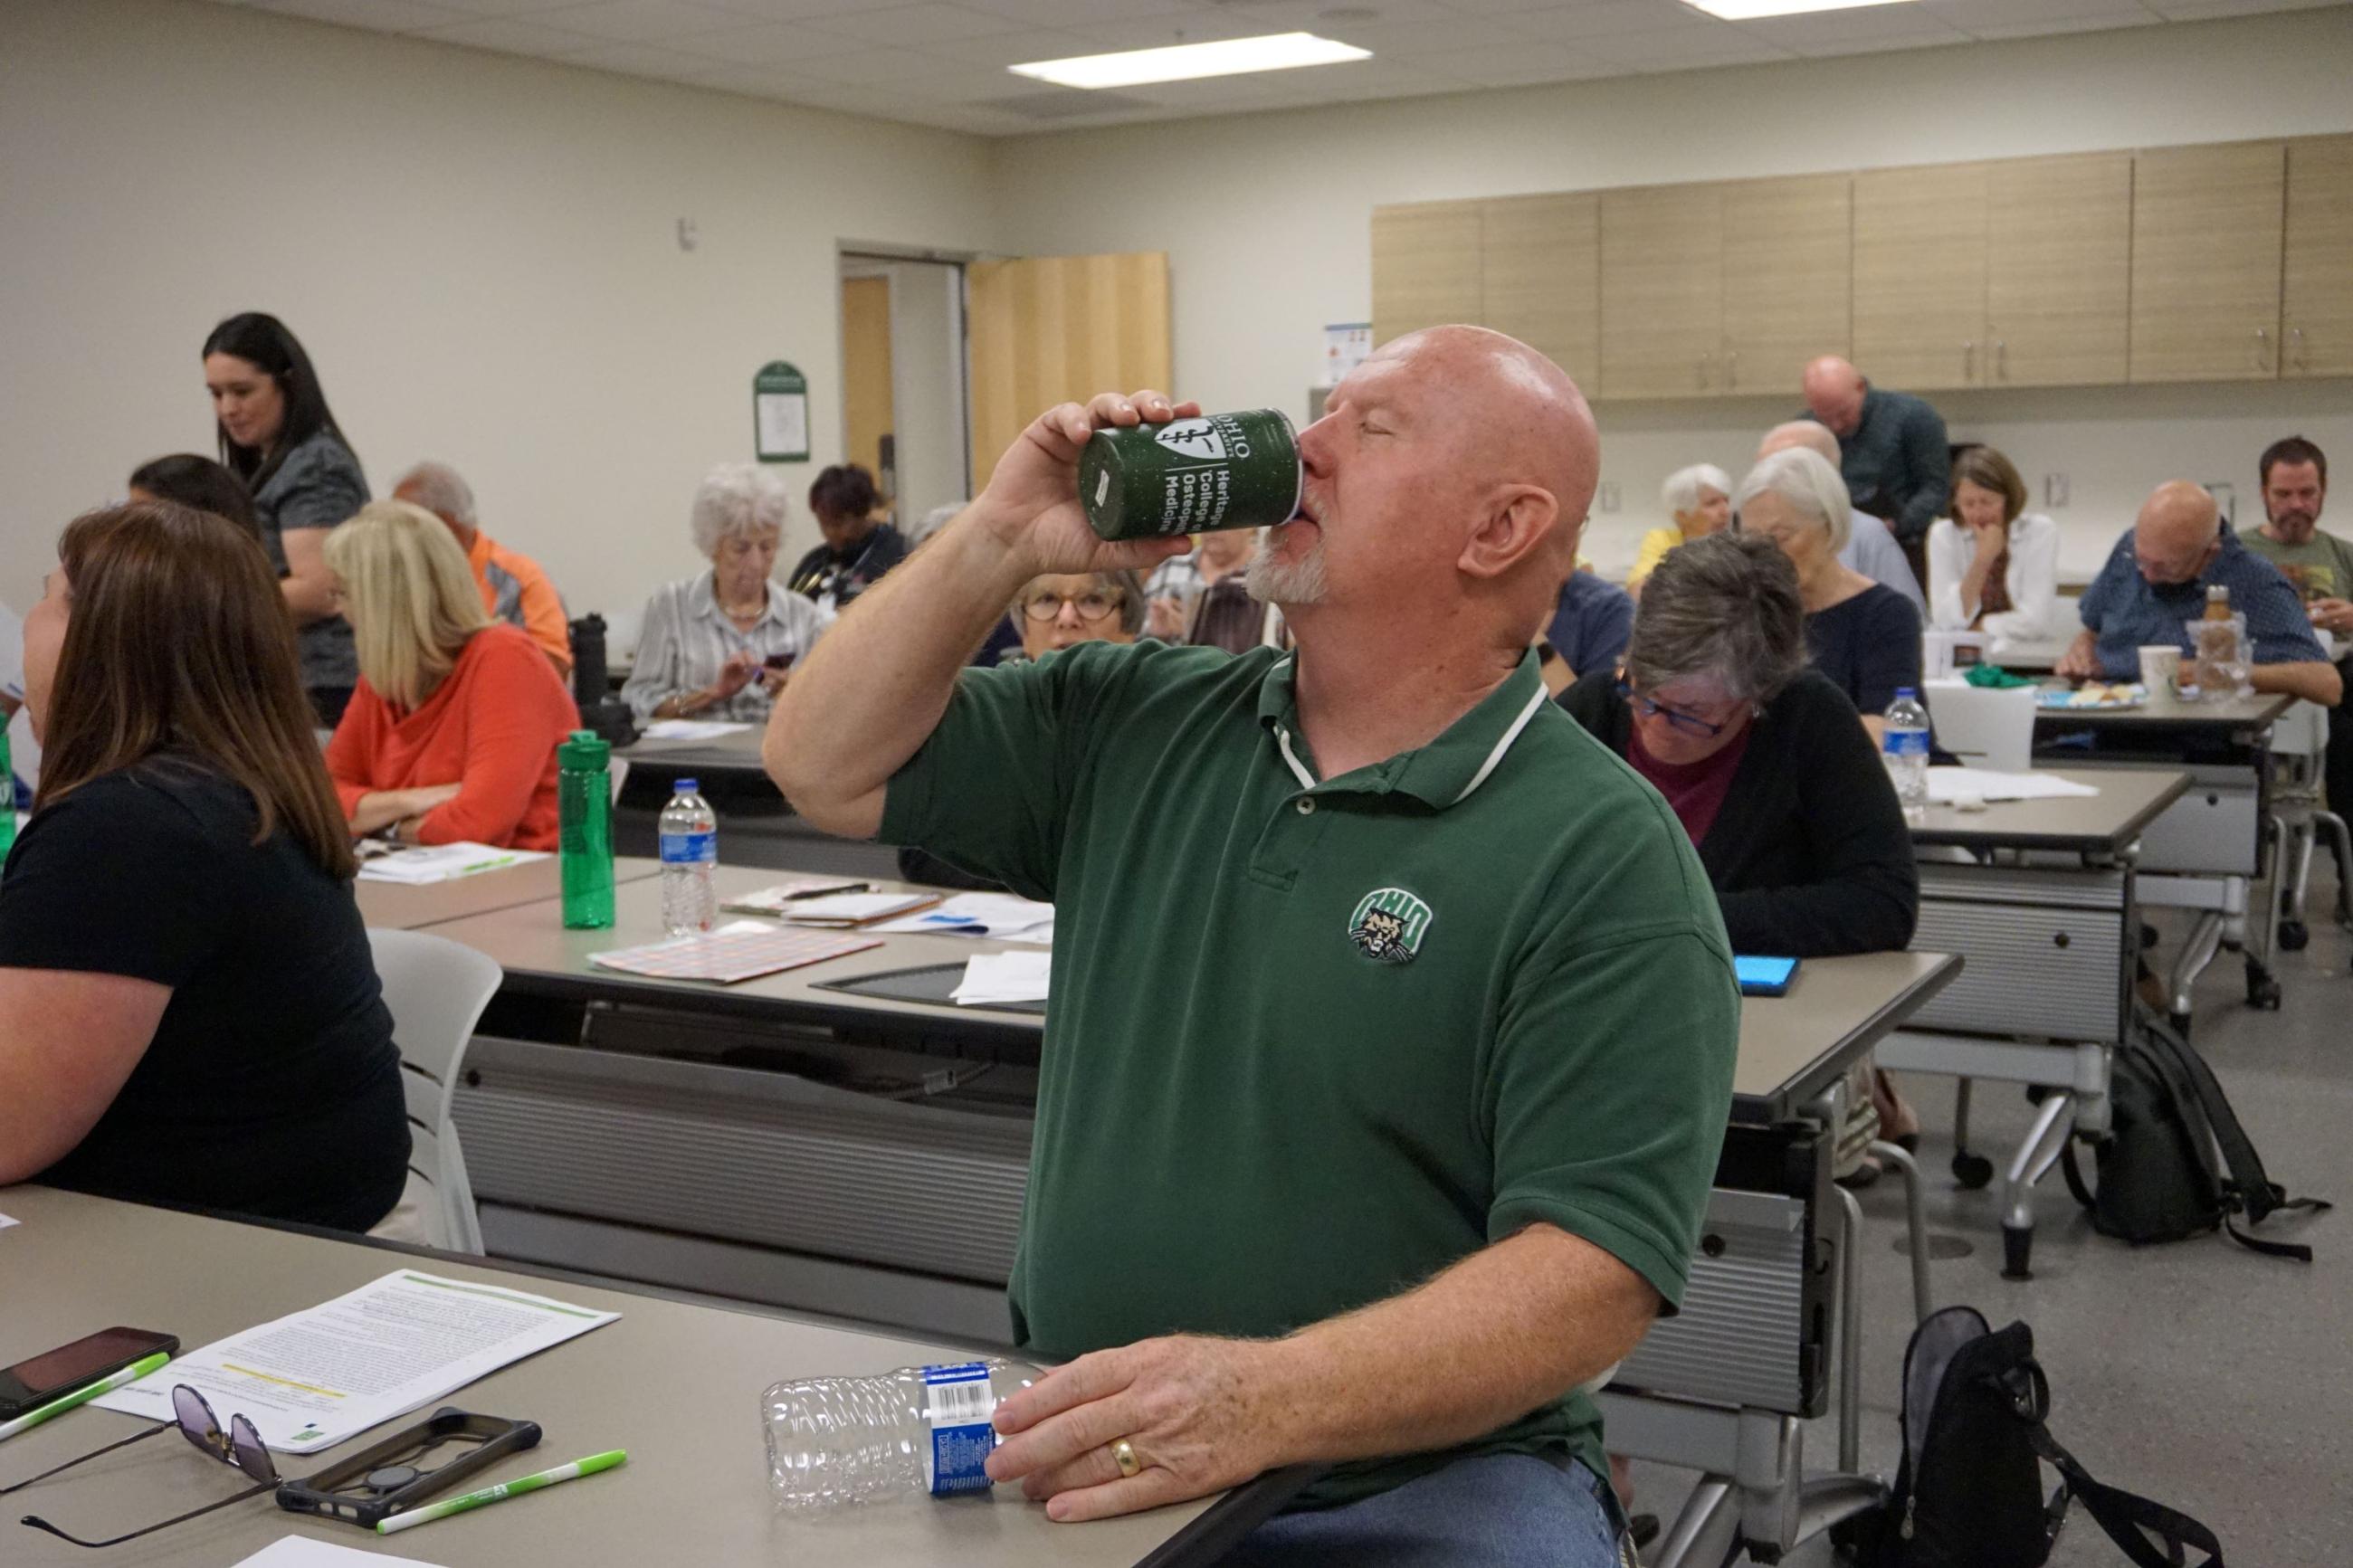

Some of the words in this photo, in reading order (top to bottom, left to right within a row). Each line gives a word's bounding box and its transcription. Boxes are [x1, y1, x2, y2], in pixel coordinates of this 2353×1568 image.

[1216, 415, 1250, 458] OHIO
[1158, 475, 1179, 532] Medicine
[1196, 472, 1213, 522] College
[1210, 470, 1230, 526] Heritage
